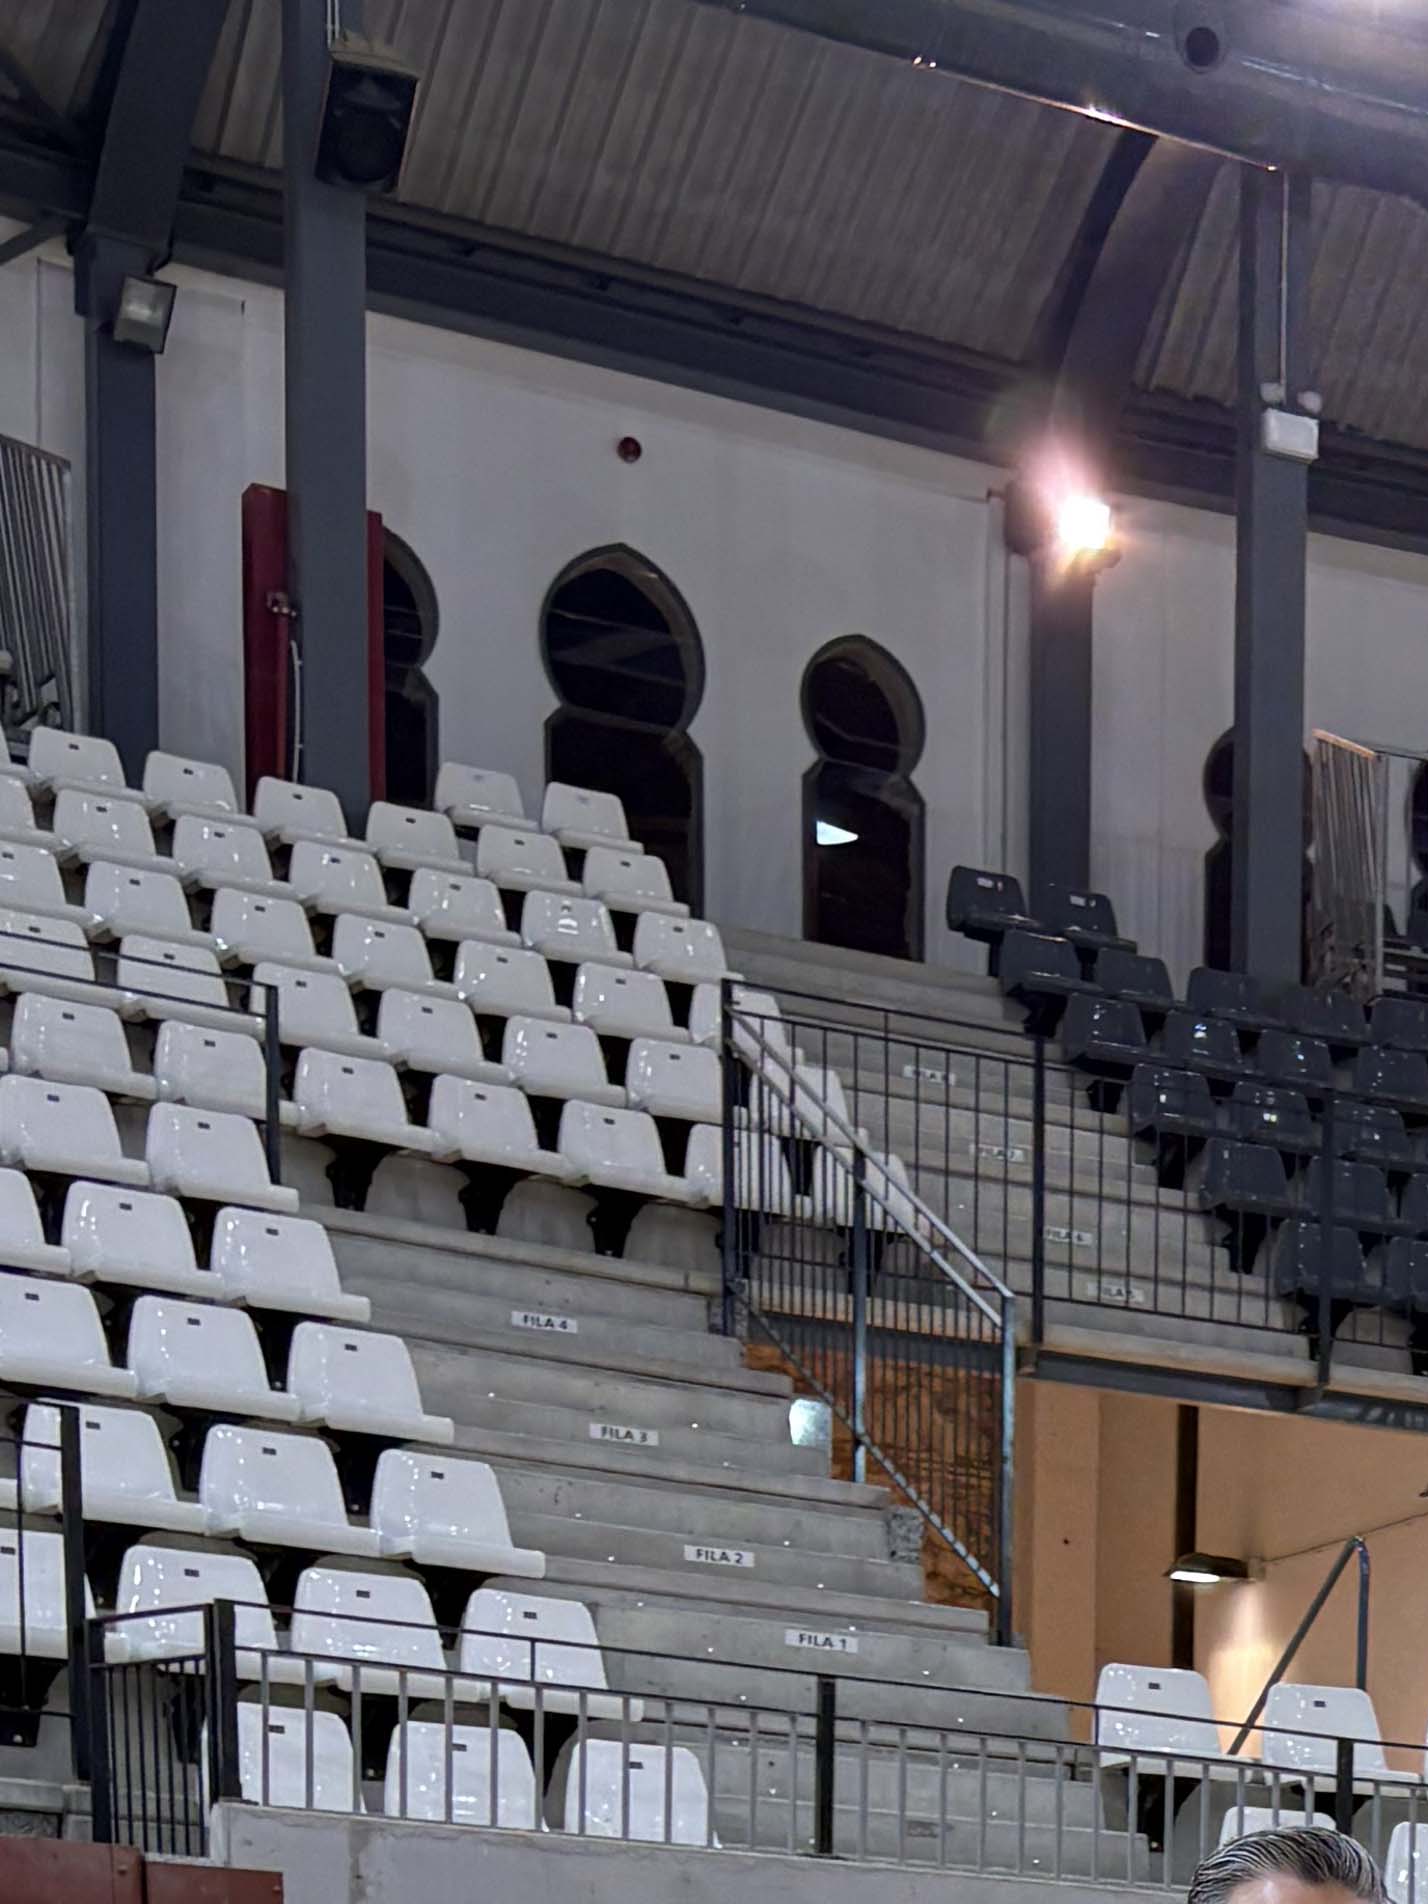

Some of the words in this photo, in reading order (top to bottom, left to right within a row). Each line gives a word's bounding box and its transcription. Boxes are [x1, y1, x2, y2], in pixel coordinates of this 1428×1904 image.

[523, 1314, 554, 1329] FILA
[558, 1320, 568, 1330] 4
[601, 1426, 634, 1440] FILA
[640, 1432, 647, 1443] 3
[696, 1549, 730, 1563] FILA
[734, 1553, 743, 1564] 2
[799, 1633, 834, 1648] FILA
[840, 1638, 847, 1648] 1
